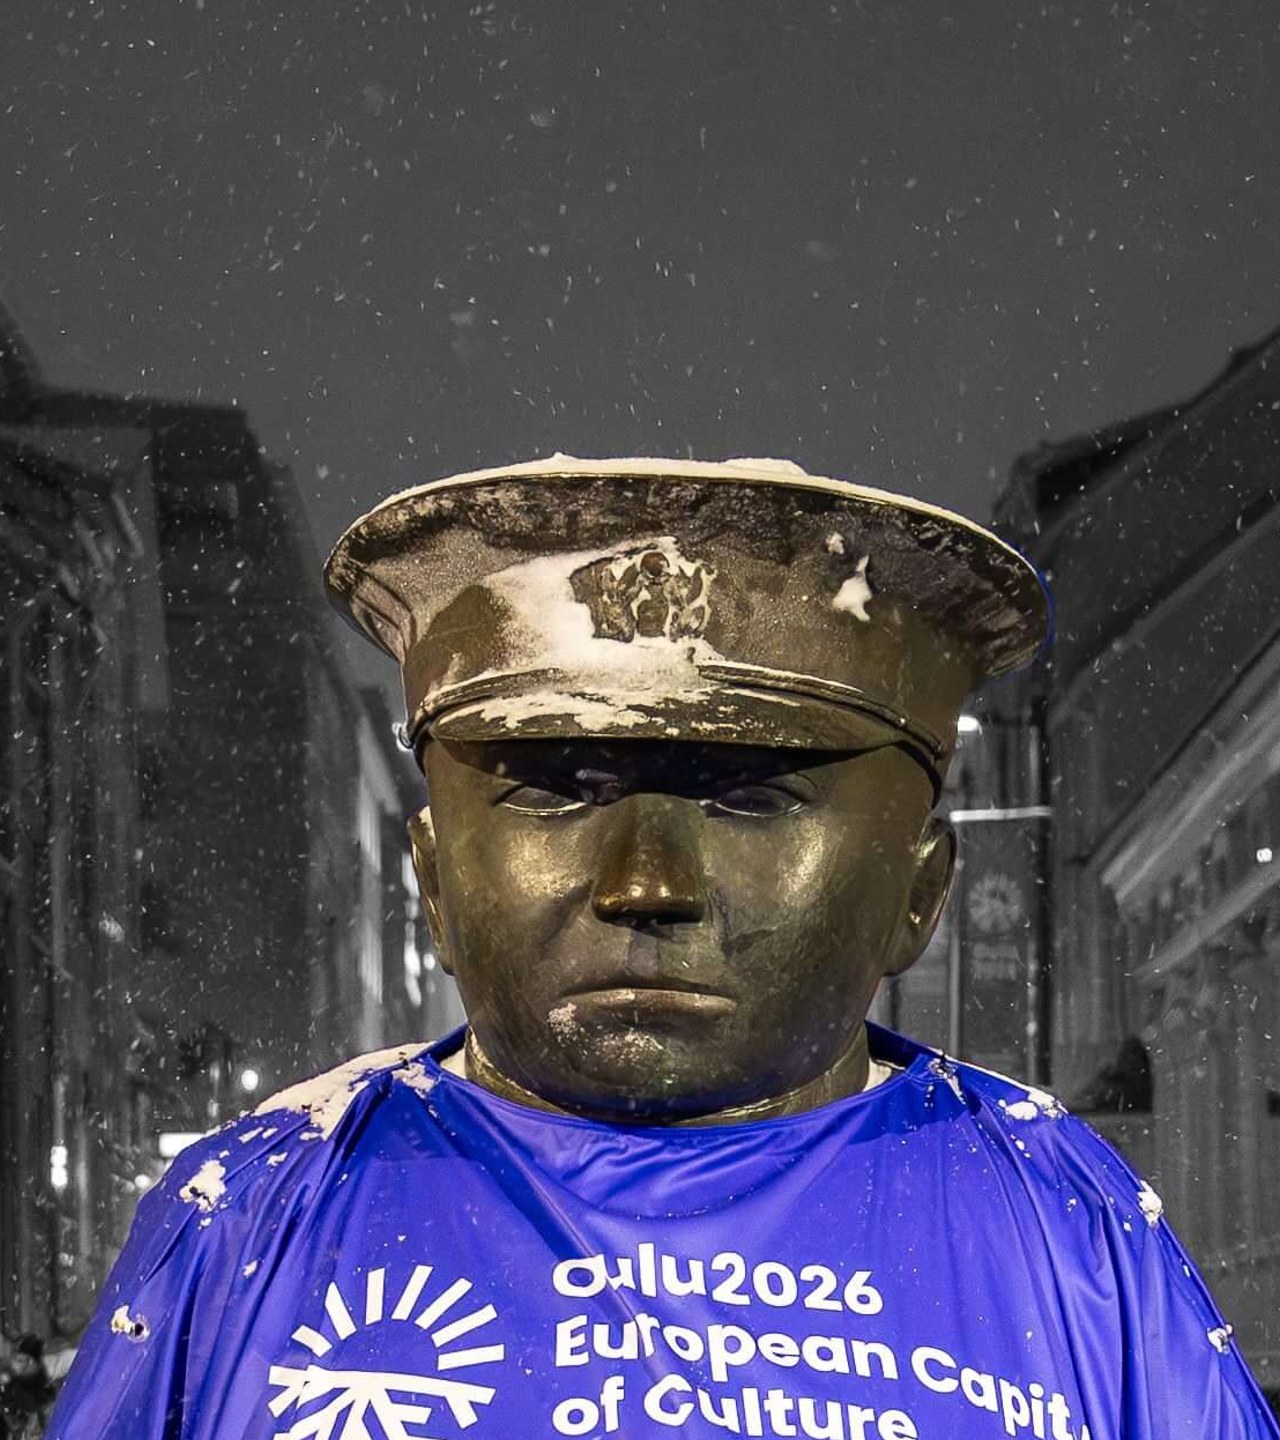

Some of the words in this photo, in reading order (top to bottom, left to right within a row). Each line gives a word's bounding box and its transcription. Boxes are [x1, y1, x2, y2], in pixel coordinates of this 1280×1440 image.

[552, 1242, 883, 1316] Oulu2026
[555, 1312, 898, 1383] European
[551, 1374, 625, 1437] of
